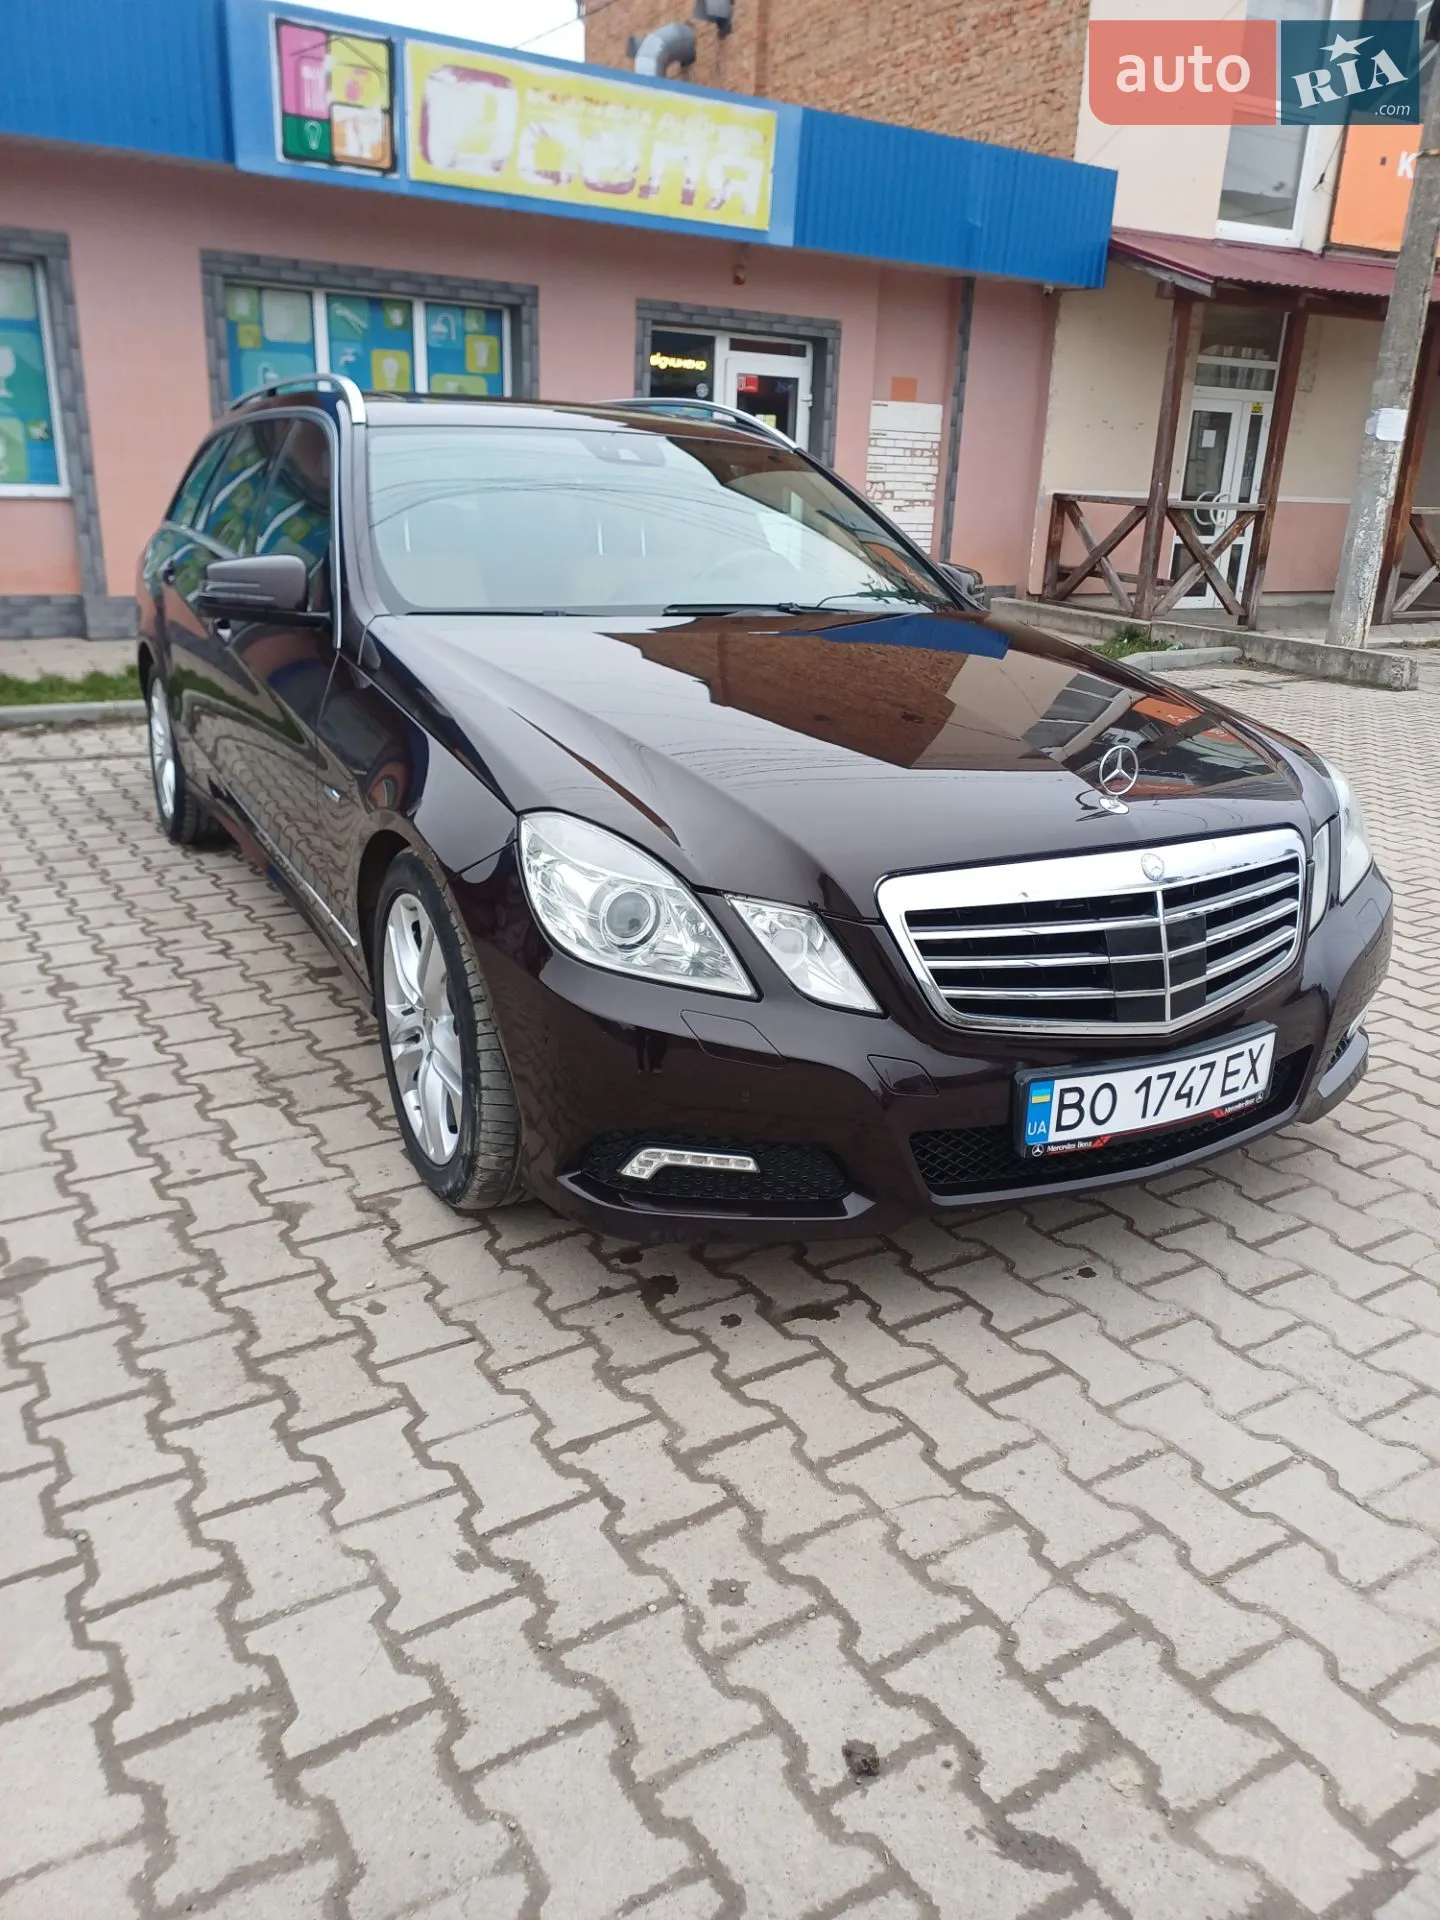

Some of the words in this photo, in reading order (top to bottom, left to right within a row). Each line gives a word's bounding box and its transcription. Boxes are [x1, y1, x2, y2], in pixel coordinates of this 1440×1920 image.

[1055, 1082, 1118, 1133] BO
[1135, 1060, 1217, 1120] 1747
[1219, 1043, 1266, 1098] EX
[1027, 1120, 1047, 1136] UA
